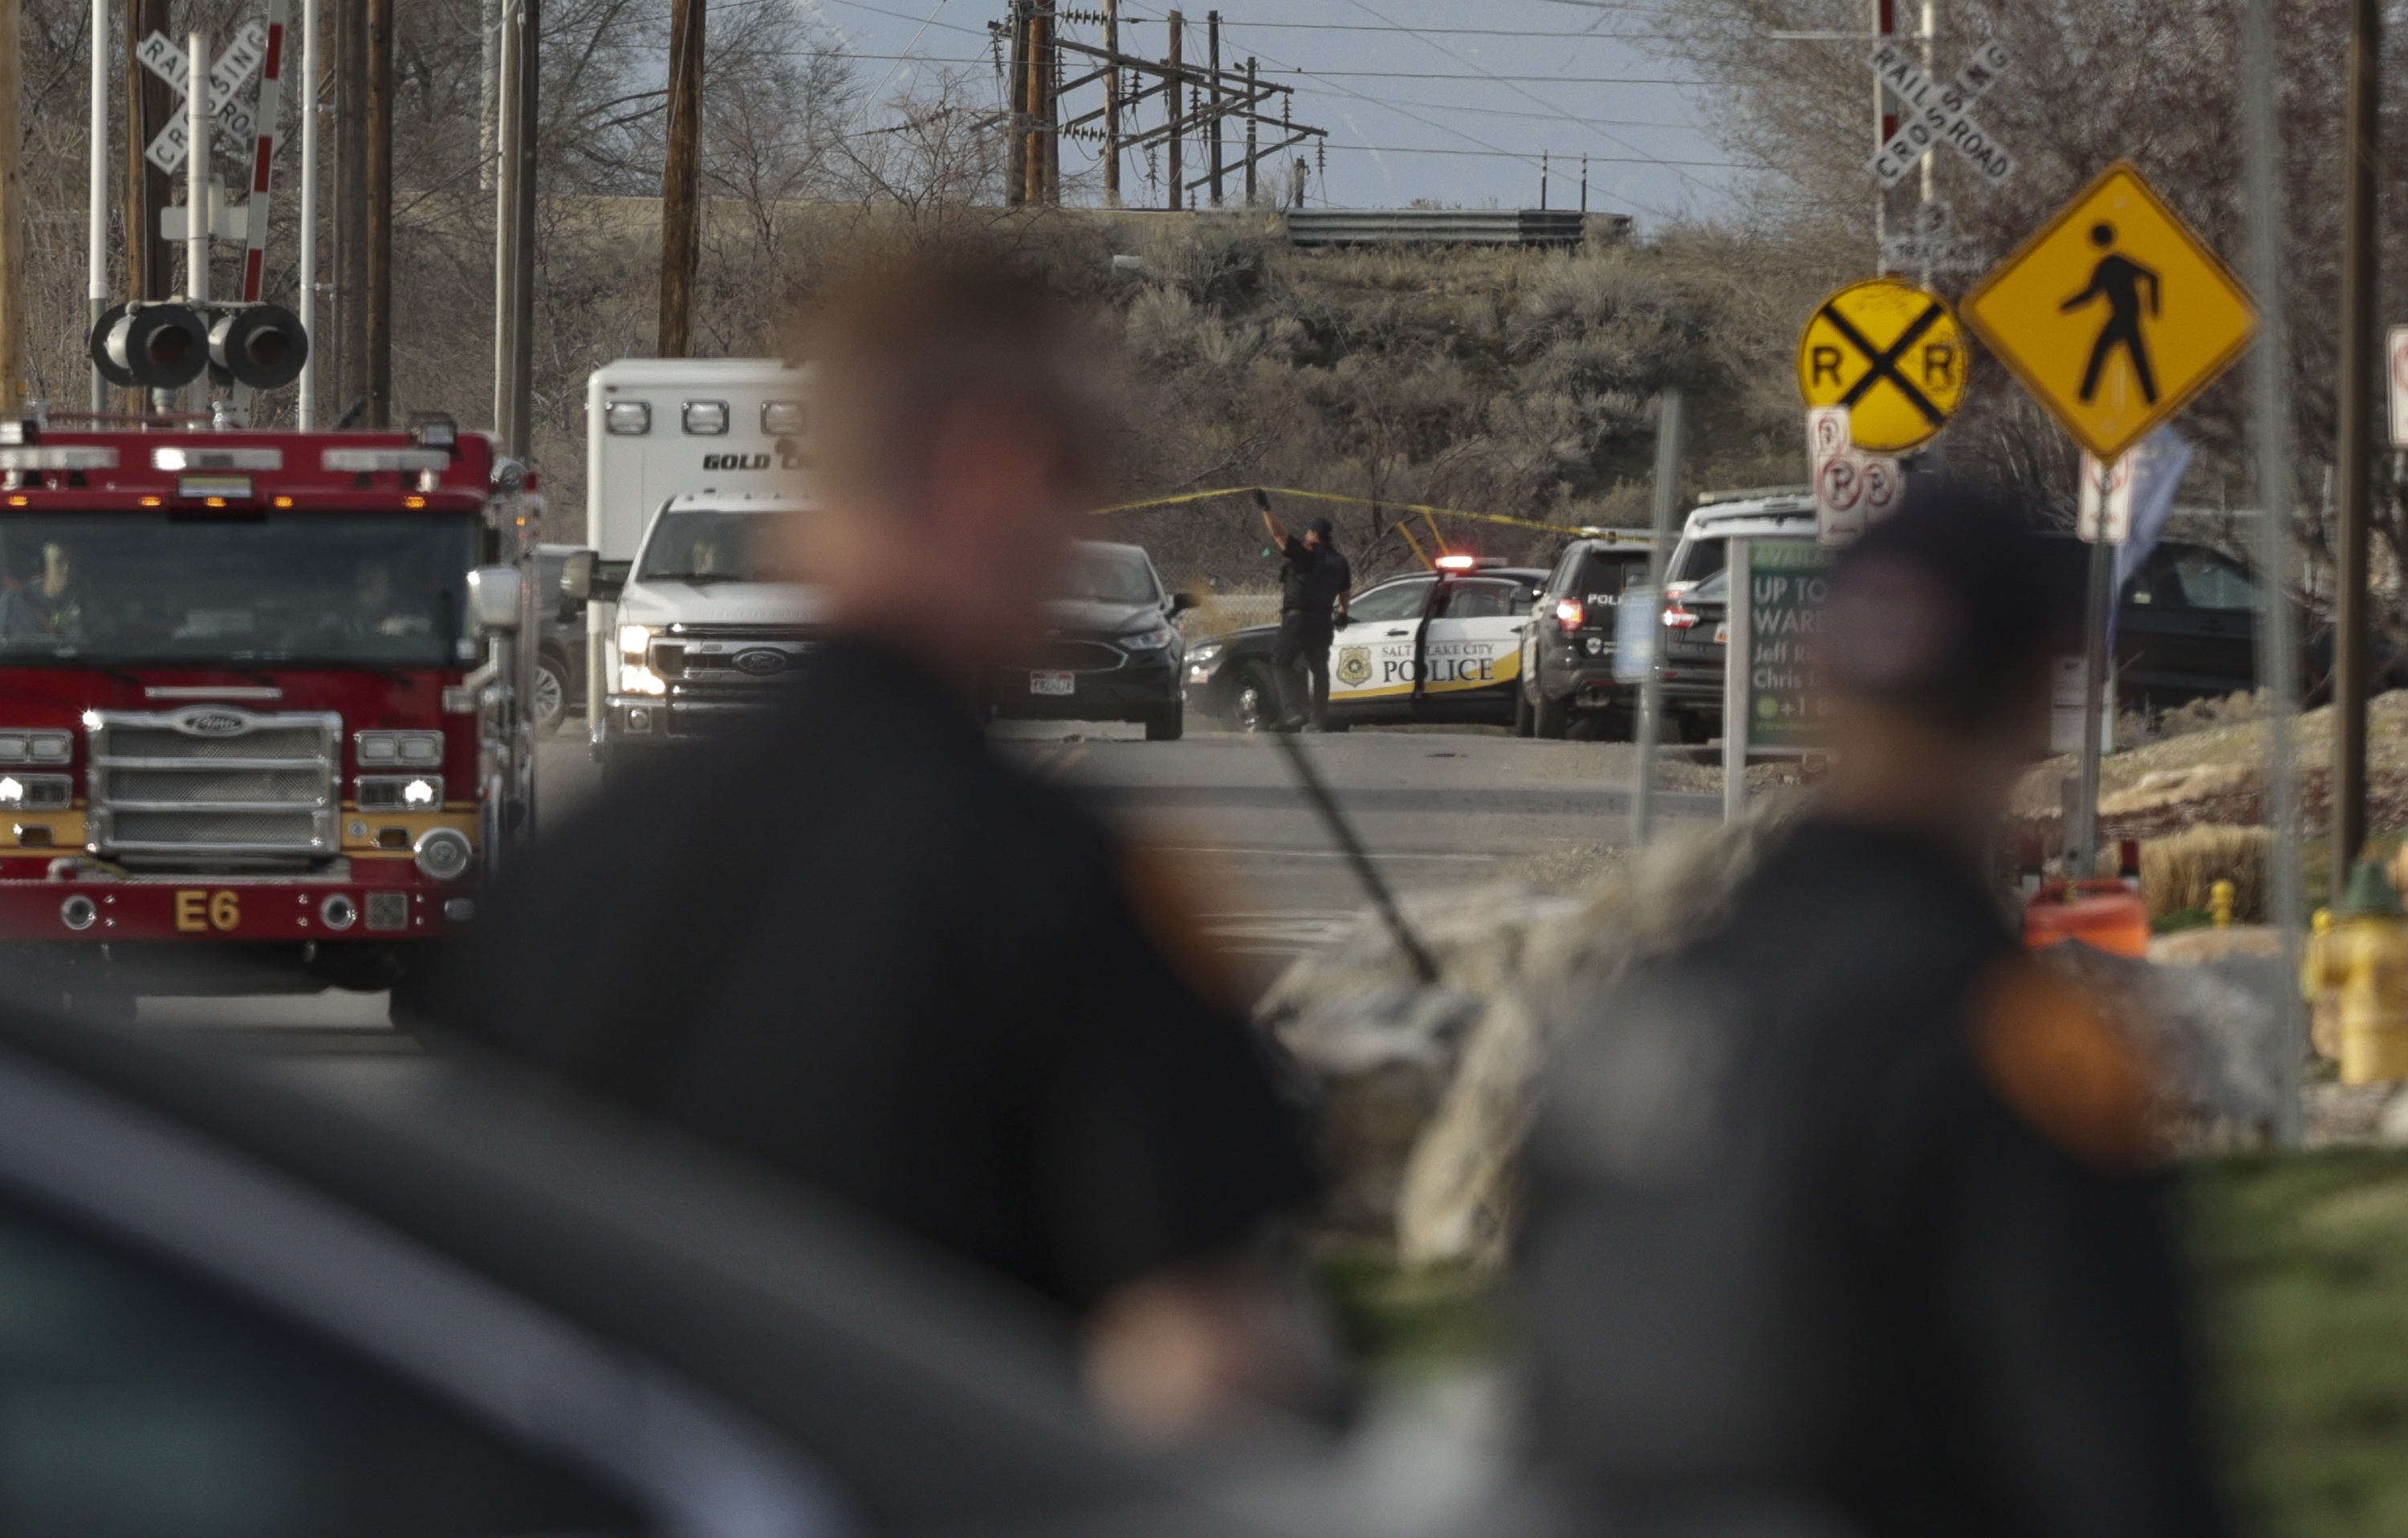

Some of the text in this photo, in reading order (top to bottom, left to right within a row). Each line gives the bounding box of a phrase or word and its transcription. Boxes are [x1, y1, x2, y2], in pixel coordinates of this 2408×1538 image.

[145, 39, 190, 92] RAI
[156, 29, 266, 165] CRSING
[1875, 45, 2008, 178] CROSSNG
[1812, 347, 1842, 386] R
[1925, 345, 1954, 384] R
[703, 454, 771, 470] GOLD
[1588, 594, 1623, 605] POLI
[1754, 576, 1828, 604] UP TO
[1382, 643, 1495, 657] SALT LAKE CITY
[1754, 641, 1788, 663] Jeff
[1382, 658, 1495, 682] POLICE
[1754, 669, 1802, 689] Chris
[177, 889, 240, 931] E6
